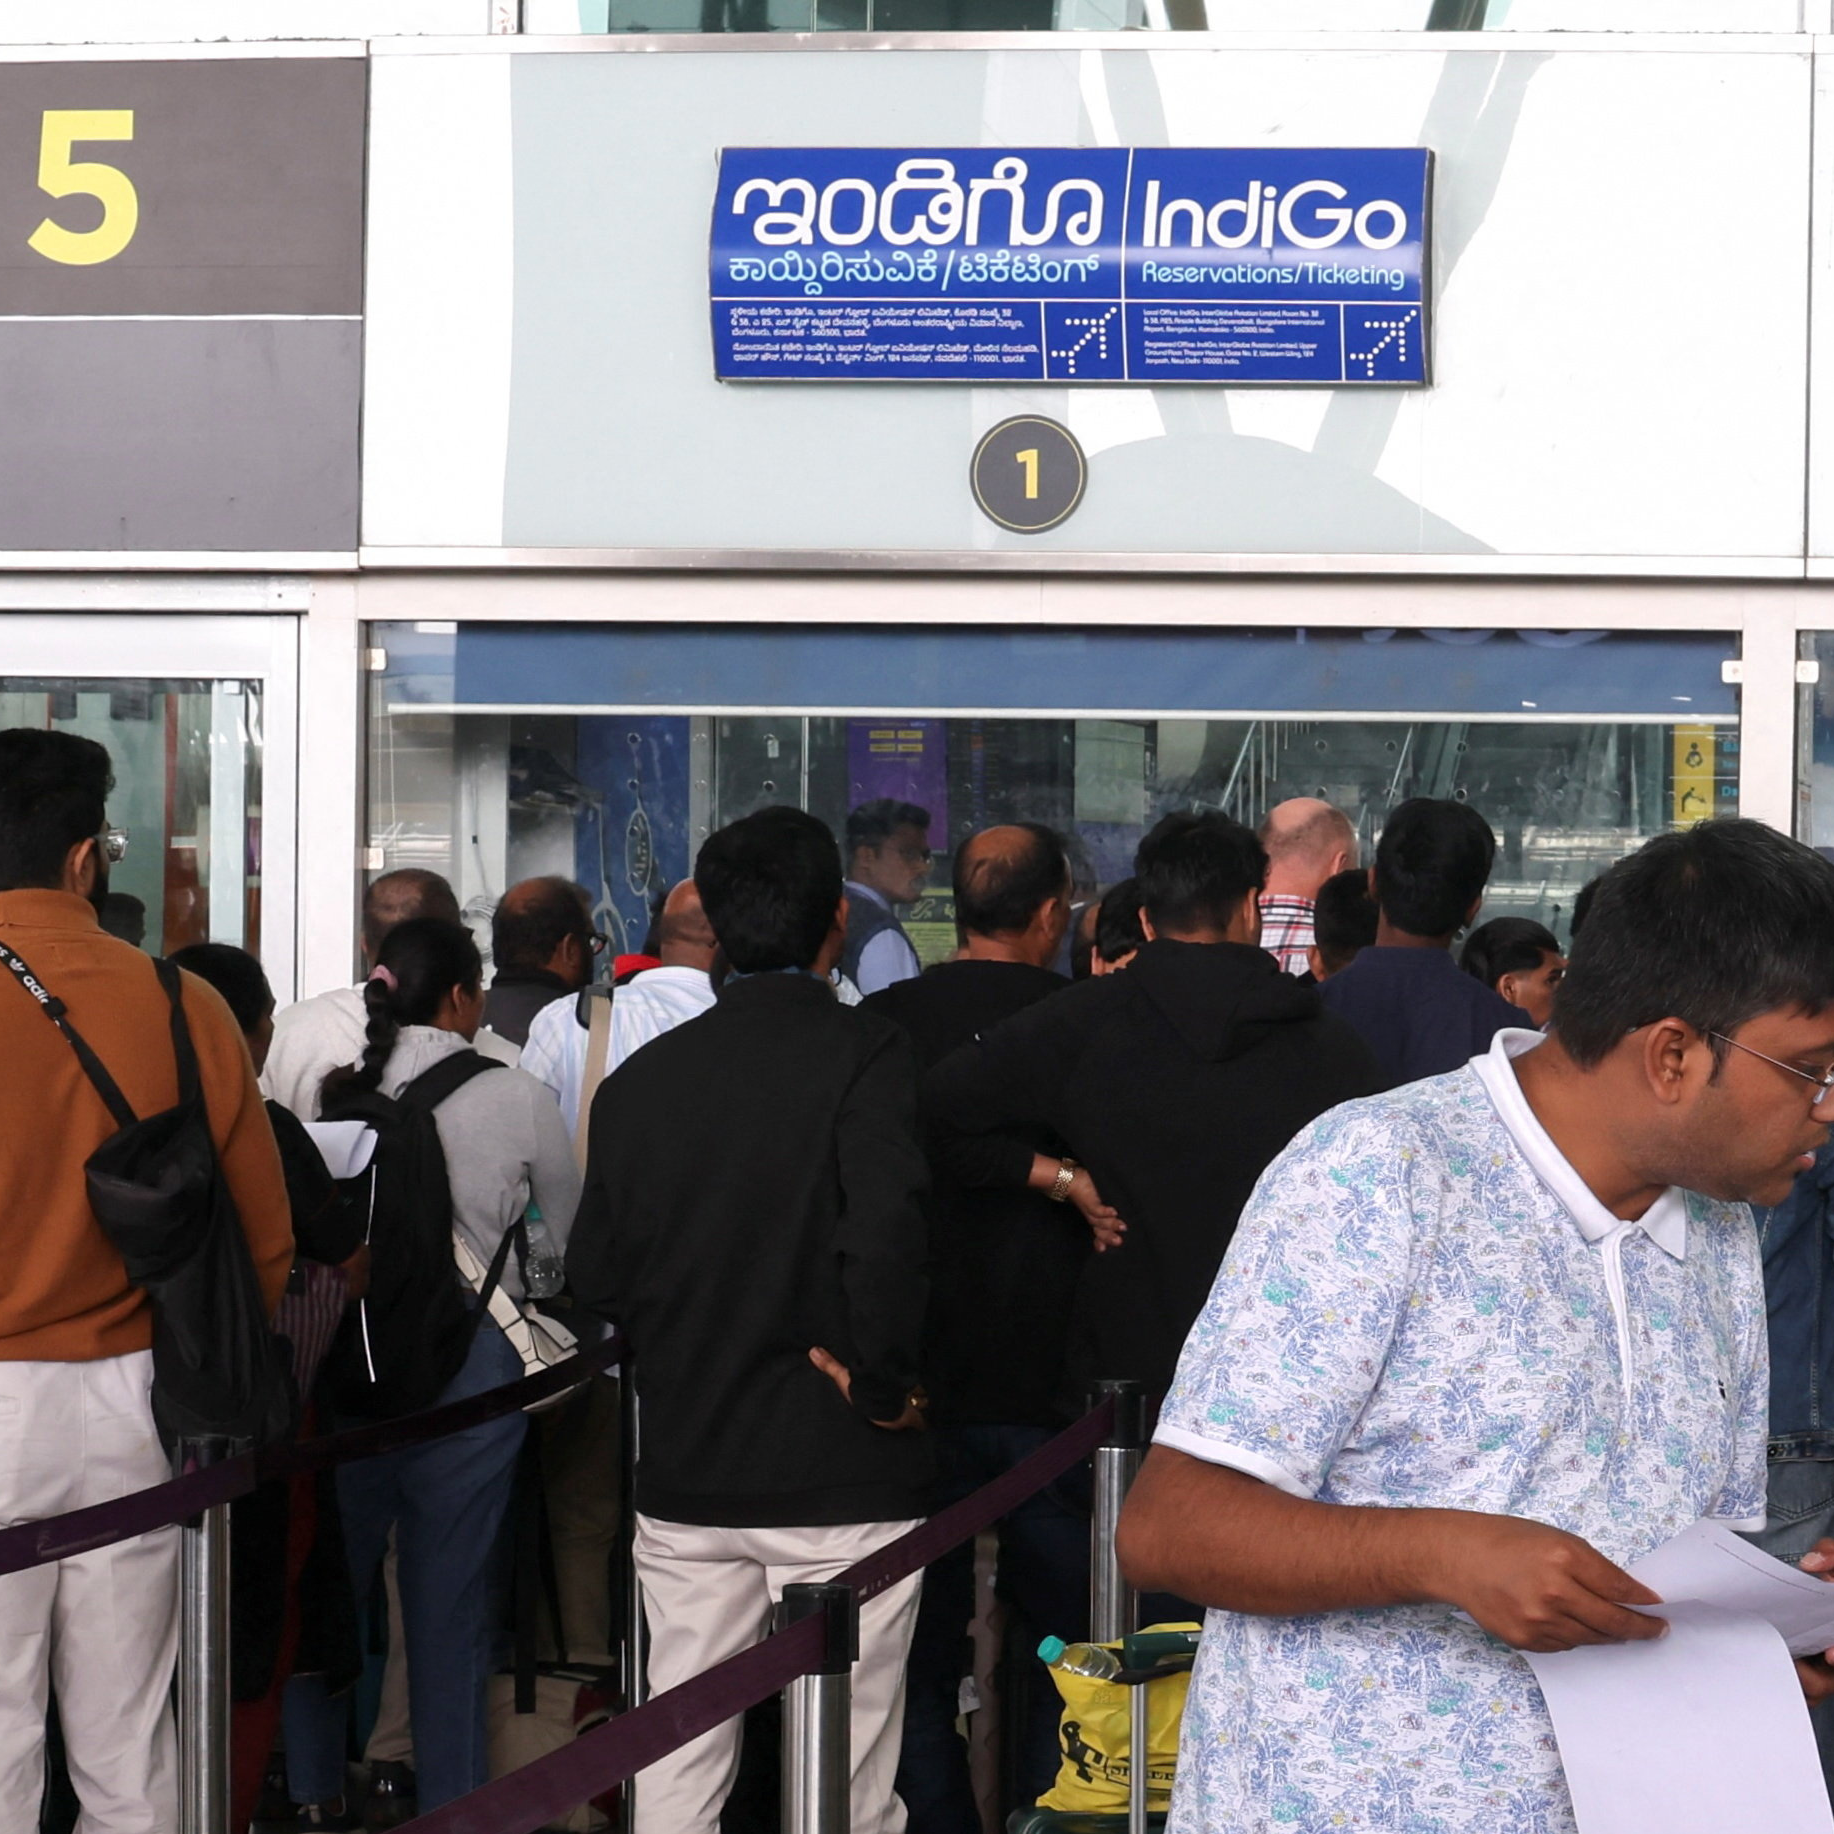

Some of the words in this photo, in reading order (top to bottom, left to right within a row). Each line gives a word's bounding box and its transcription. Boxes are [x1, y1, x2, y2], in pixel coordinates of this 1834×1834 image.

[28, 109, 138, 265] 5
[1144, 179, 1406, 250] IndiGo
[1142, 260, 1405, 292] Reservations/Ticketing
[1015, 449, 1039, 499] 1
